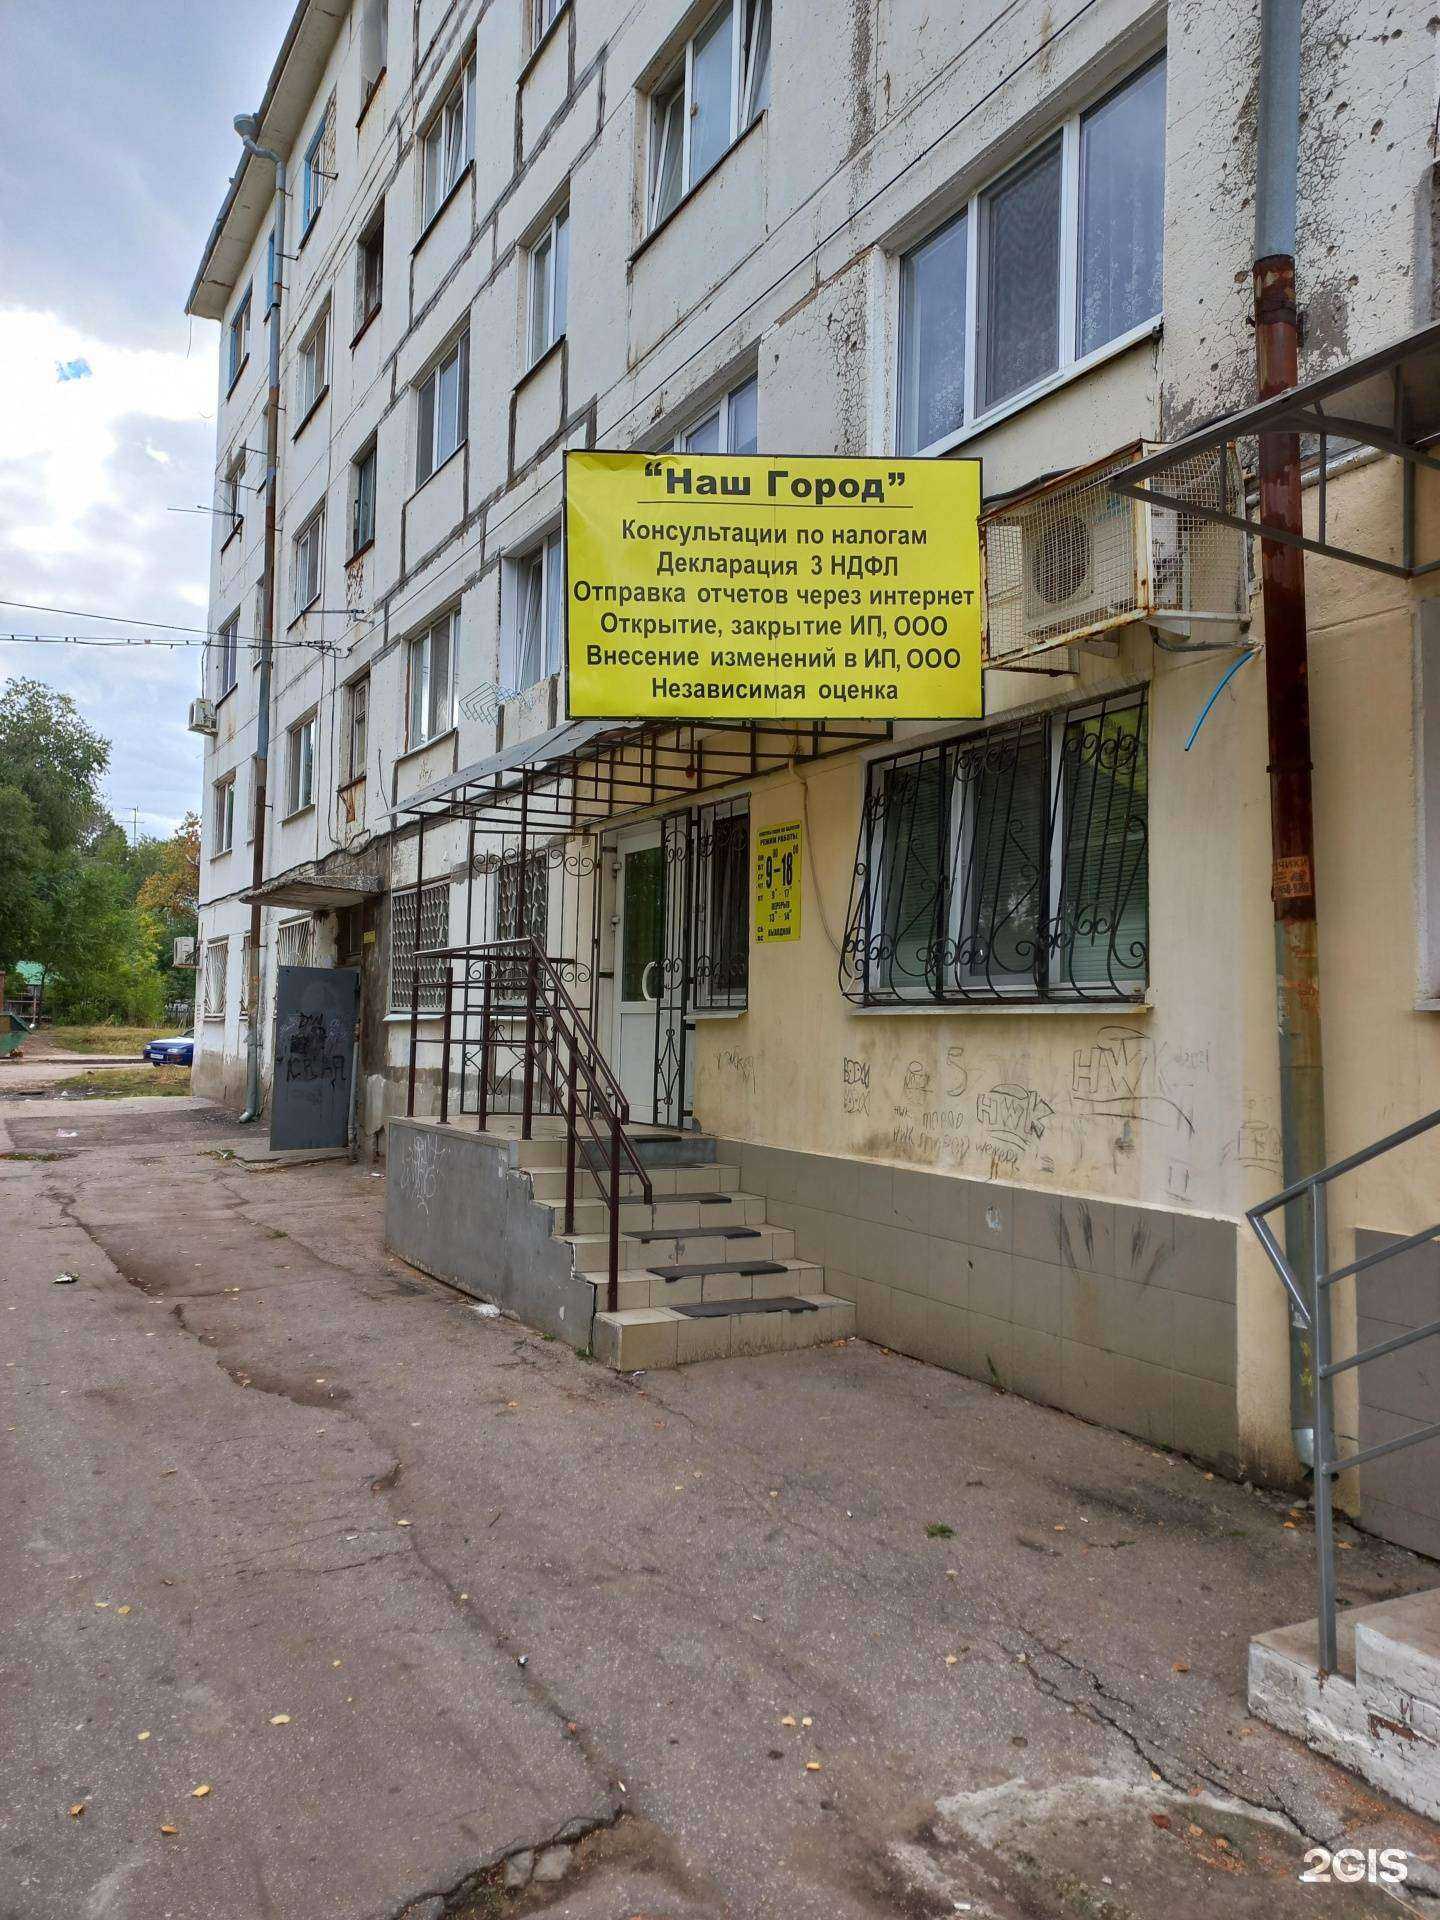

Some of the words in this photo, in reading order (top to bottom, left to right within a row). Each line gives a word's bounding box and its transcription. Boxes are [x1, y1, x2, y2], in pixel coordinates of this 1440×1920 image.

[622, 519, 787, 546] Консультации
[796, 528, 823, 545] по
[832, 528, 927, 546] налогам
[656, 551, 798, 580] Декларация
[810, 554, 823, 576] 3
[830, 554, 898, 581] НДФЛ
[573, 580, 686, 607] Отправка
[697, 587, 788, 604] отчетов
[796, 588, 862, 610] через
[869, 589, 975, 606] интернет
[600, 611, 724, 639] Открытие,
[731, 618, 842, 640] закрытие
[586, 644, 700, 667] Внесение
[710, 645, 836, 669] изменений
[844, 654, 857, 668] в
[652, 677, 806, 700] Независимая
[818, 684, 898, 703] оценка
